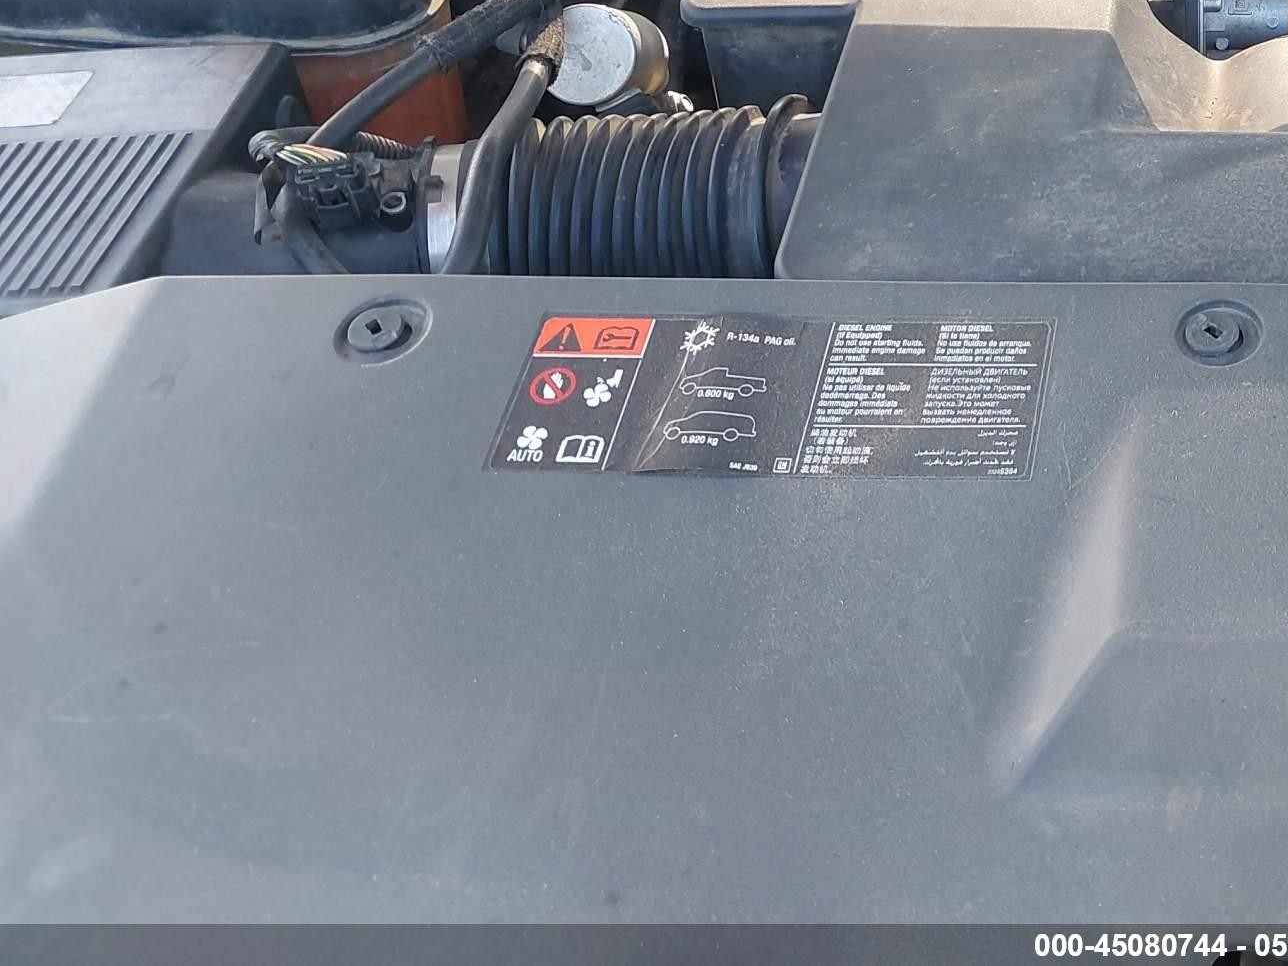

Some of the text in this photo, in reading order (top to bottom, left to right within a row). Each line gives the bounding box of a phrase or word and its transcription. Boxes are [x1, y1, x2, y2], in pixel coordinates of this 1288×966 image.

[726, 331, 760, 343] R-134a
[763, 335, 783, 345] PAG
[846, 332, 883, 340] Equipped)
[873, 339, 900, 347] starting
[897, 347, 925, 355] damage
[975, 347, 1004, 355] producir
[930, 368, 1028, 376] ДИЗЕЛЬНЫЙ ДВИГАТЕЛЬ
[952, 376, 1001, 384] установлен)
[834, 385, 847, 393] pas
[940, 384, 991, 392] используйте
[723, 390, 735, 401] kg
[818, 400, 858, 408] dommages
[855, 408, 892, 416] pourraient
[707, 436, 719, 447] kg
[506, 449, 544, 462] AUTO
